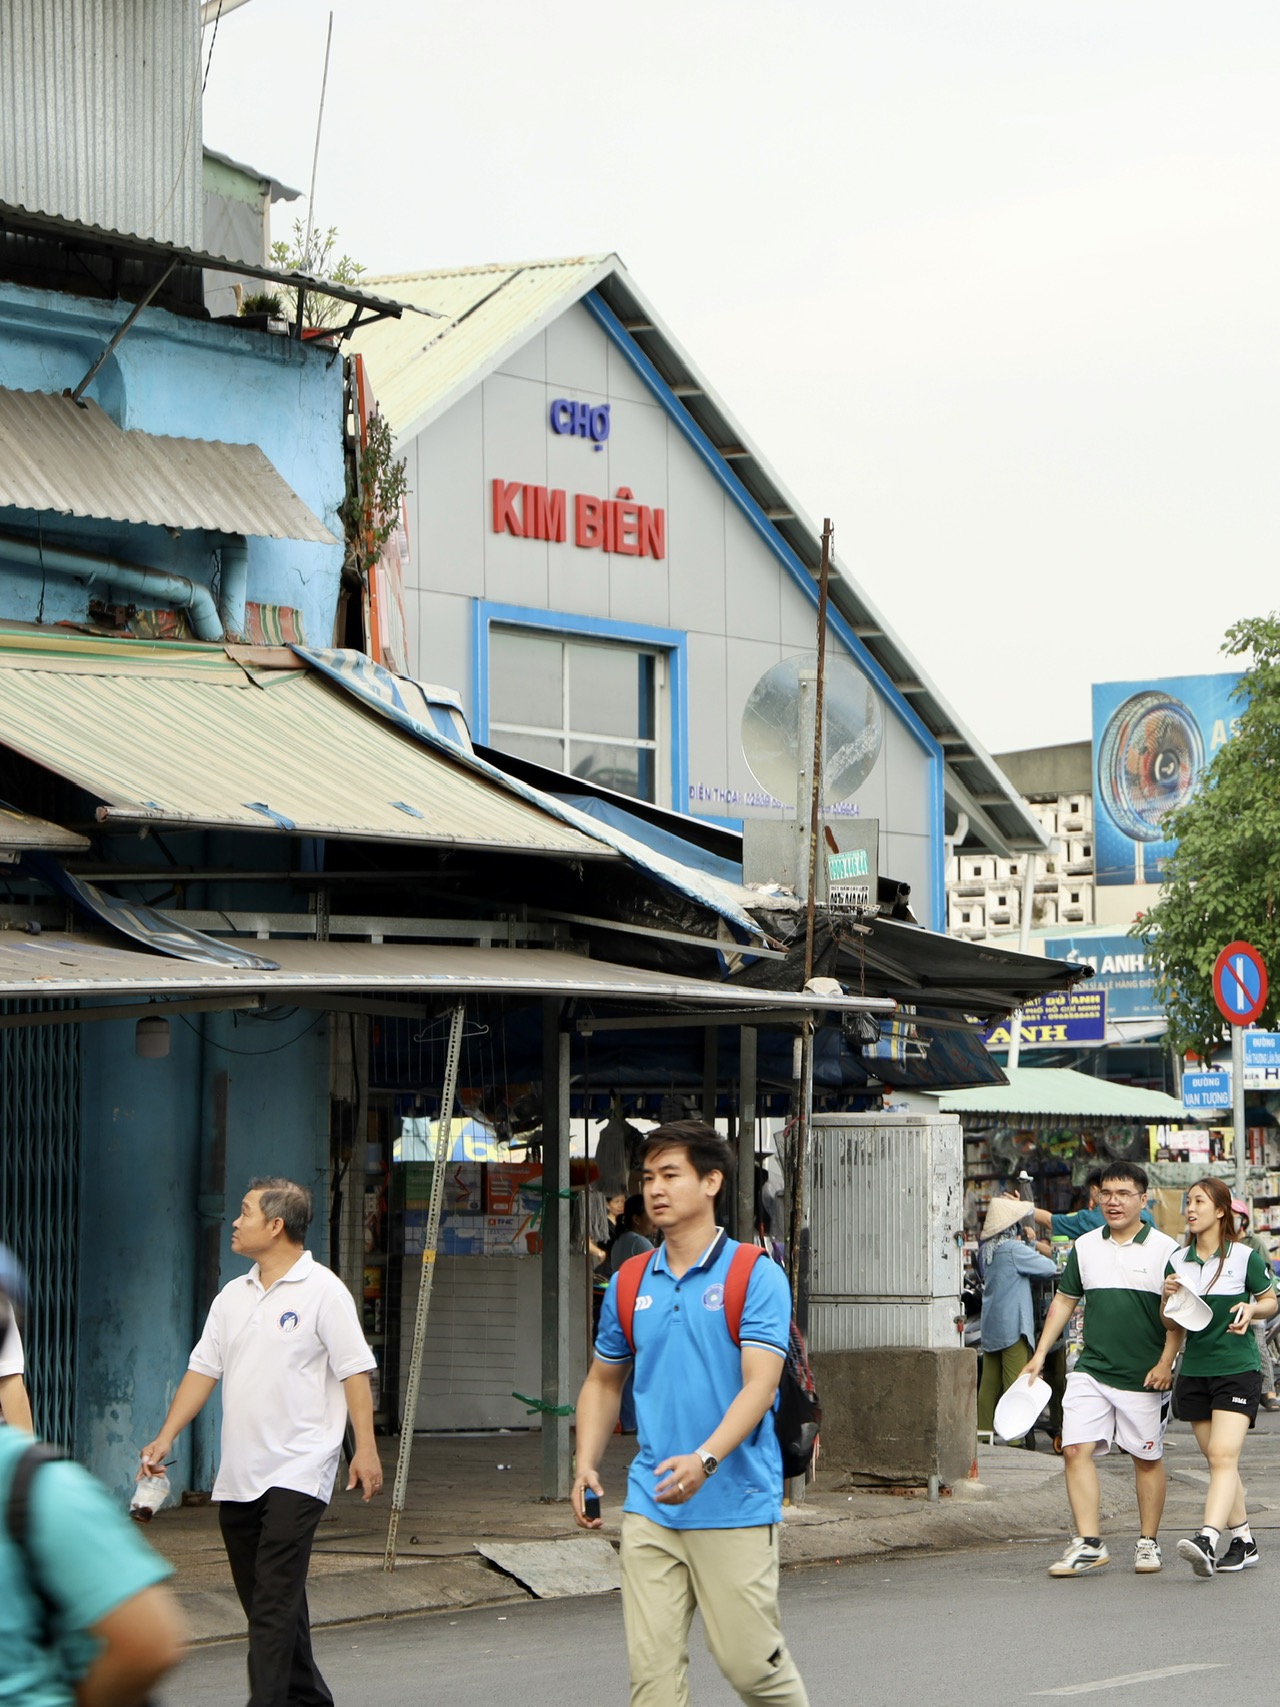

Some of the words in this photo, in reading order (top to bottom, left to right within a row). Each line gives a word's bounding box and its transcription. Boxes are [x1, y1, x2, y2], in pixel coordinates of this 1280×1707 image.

[551, 398, 610, 452] CHỢ
[492, 478, 567, 543] KIM
[574, 486, 665, 561] BIÊN
[689, 782, 711, 801] ĐIỆN
[1071, 995, 1100, 1004] ANH
[1025, 1005, 1044, 1014] PHỐ
[1045, 1005, 1058, 1013] HỒ
[1078, 1004, 1100, 1012] MINH
[1252, 1035, 1276, 1047] ĐƯỜNG
[1192, 1075, 1220, 1087] ĐƯỜNG
